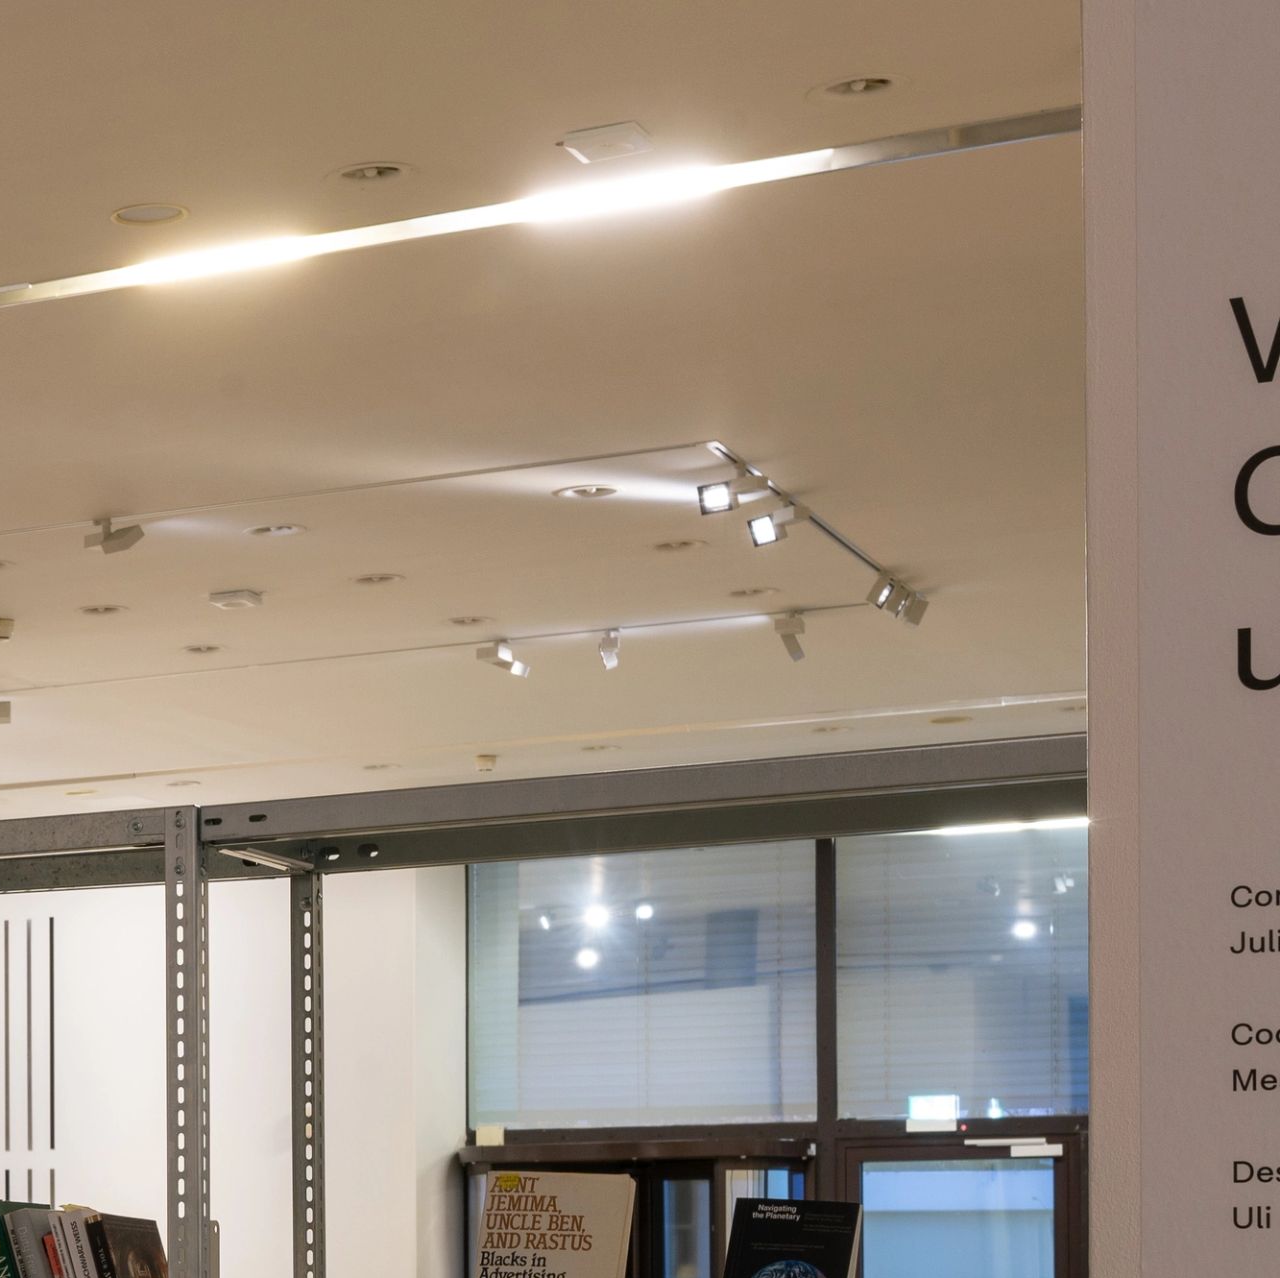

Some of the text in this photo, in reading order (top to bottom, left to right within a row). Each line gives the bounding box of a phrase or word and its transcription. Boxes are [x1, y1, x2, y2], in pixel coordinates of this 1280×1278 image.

[486, 1195, 562, 1214] JEMIMA,
[758, 1204, 797, 1214] Navigating
[486, 1213, 586, 1233] UNCLE BEN,
[752, 1211, 801, 1222] the Planetary
[1233, 1206, 1271, 1229] Uli
[71, 1221, 81, 1242] WEISS
[482, 1232, 593, 1251] AND RASTUS
[480, 1251, 546, 1267] Blacks in
